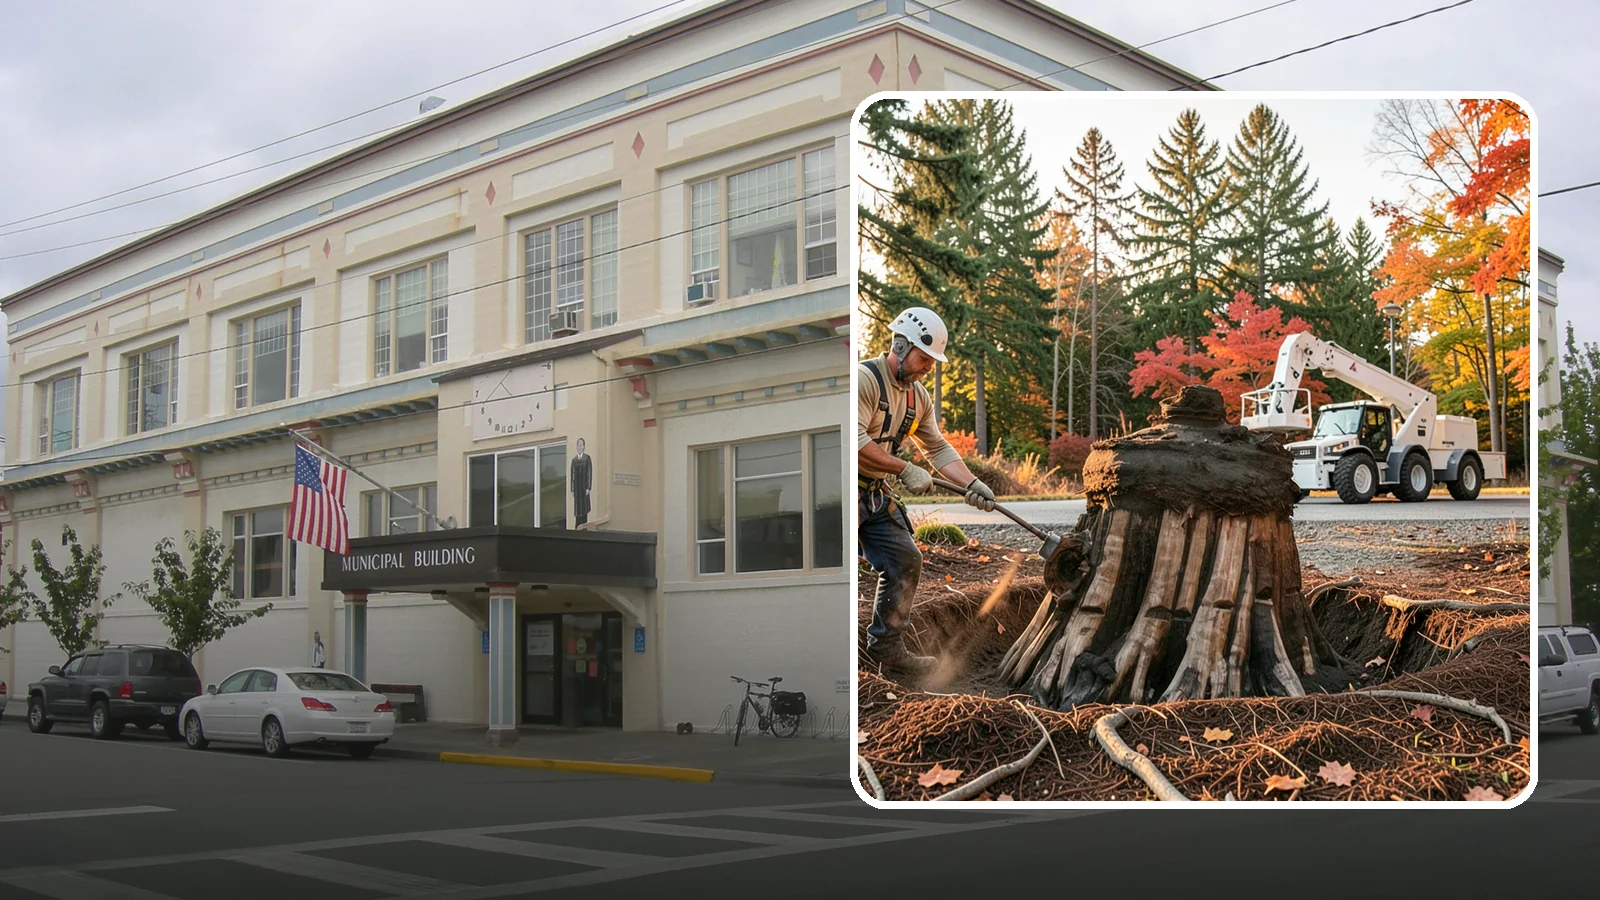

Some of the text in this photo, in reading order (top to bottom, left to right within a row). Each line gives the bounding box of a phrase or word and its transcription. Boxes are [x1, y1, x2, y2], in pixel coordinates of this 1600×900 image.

[475, 390, 480, 398] 7
[536, 402, 540, 410] 4
[480, 407, 485, 415] 8
[487, 417, 493, 426] 9
[494, 423, 500, 432] 10
[501, 425, 506, 434] 11
[507, 425, 514, 433] 12
[520, 420, 526, 428] 2
[528, 414, 533, 422] 3
[342, 546, 475, 572] MUNICIPAL BUILDING
